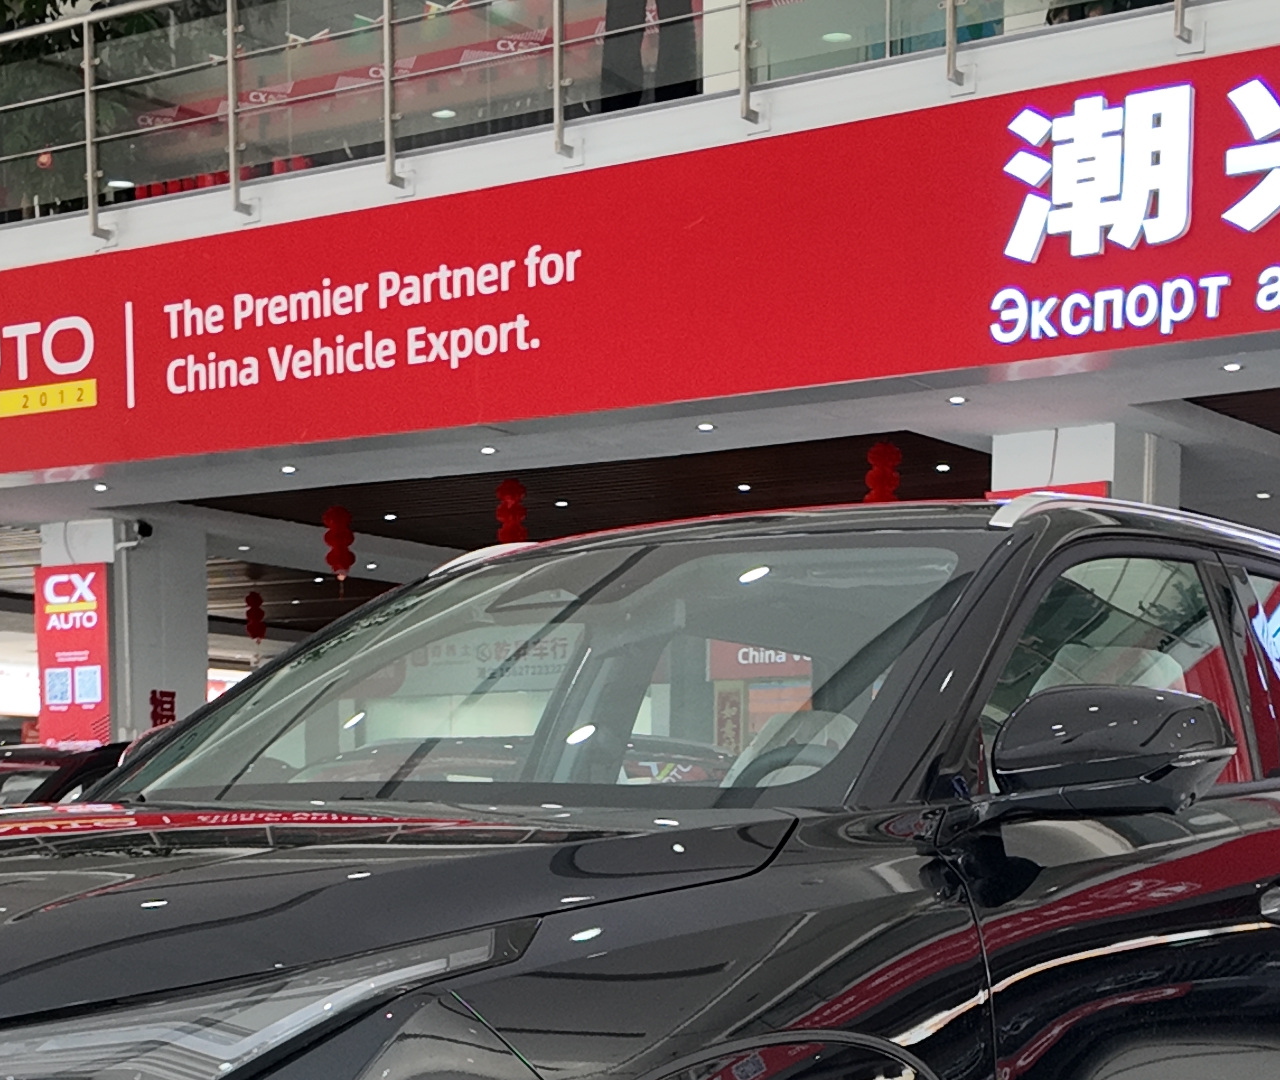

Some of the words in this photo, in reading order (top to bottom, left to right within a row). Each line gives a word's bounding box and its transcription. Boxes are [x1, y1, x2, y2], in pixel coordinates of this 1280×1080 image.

[163, 300, 226, 342] The
[233, 279, 369, 328] Premier
[377, 264, 516, 313] Partner
[523, 244, 584, 288] for
[989, 273, 1232, 344] Экспорт
[165, 351, 260, 396] China
[268, 329, 397, 383] Vehicle
[406, 315, 541, 372] Export.
[21, 387, 89, 411] 2012
[42, 571, 97, 604] CX
[46, 611, 98, 631] AUTO
[737, 647, 787, 665] China
